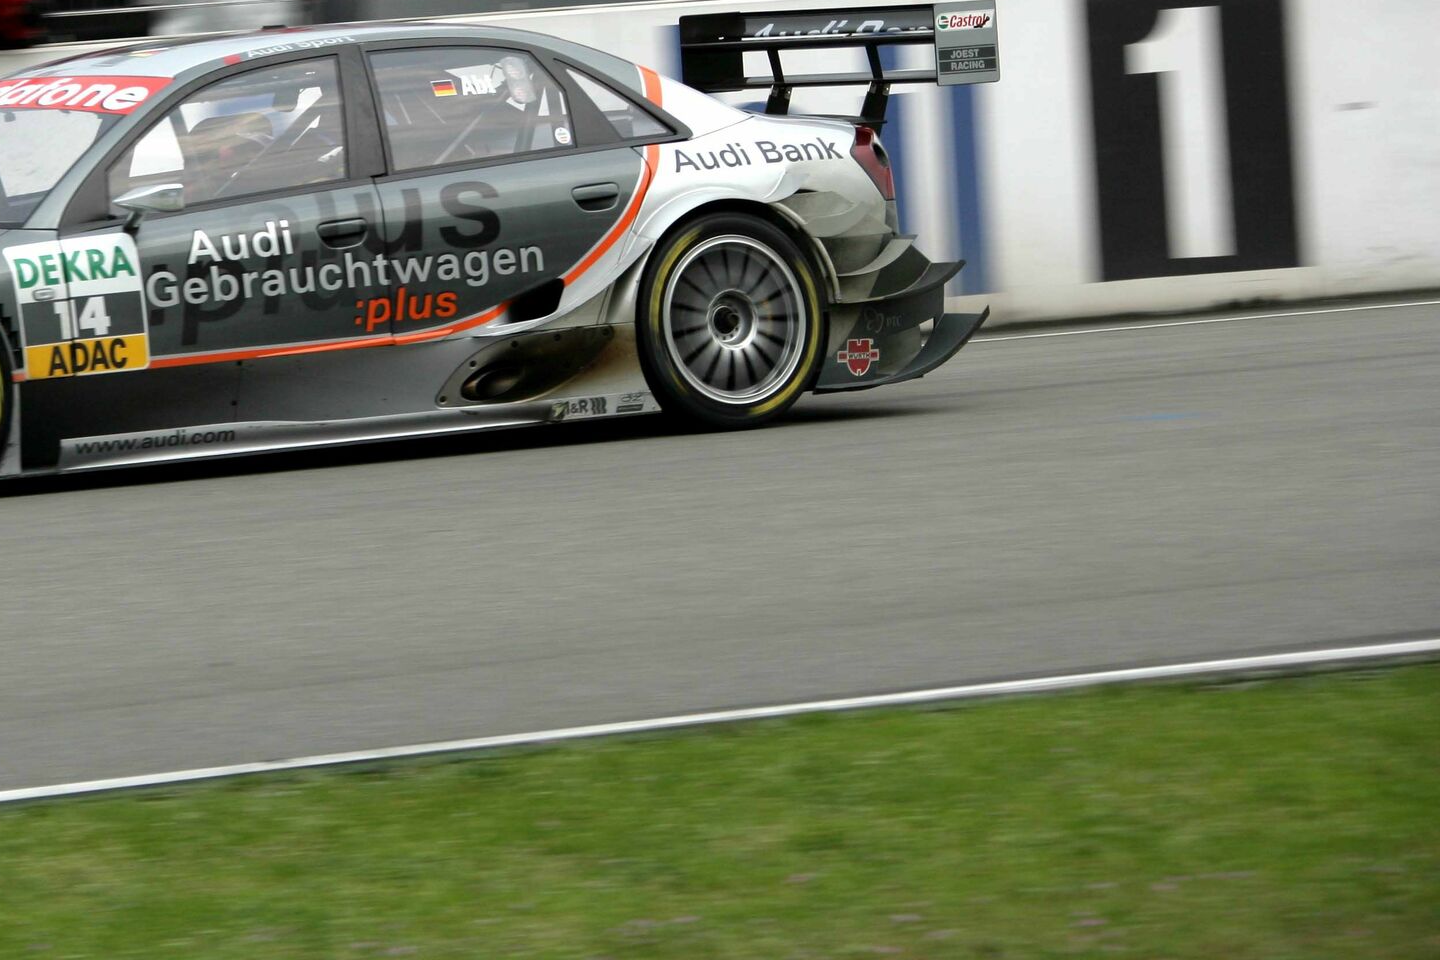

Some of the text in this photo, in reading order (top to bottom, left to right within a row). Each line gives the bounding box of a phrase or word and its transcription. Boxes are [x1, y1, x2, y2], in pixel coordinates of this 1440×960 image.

[948, 11, 991, 29] Castrol
[246, 35, 357, 59] Audi Sport
[950, 48, 980, 60] JOEST
[950, 60, 986, 72] RACING
[674, 137, 844, 173] Audi Bank
[187, 219, 294, 265] Audi
[13, 245, 136, 290] DEKRA
[145, 245, 545, 309] Gebrauchtwagen
[53, 295, 112, 340] 14
[353, 286, 459, 332] :plus
[48, 338, 128, 377] ADAC
[74, 429, 236, 455] www.audi.com
